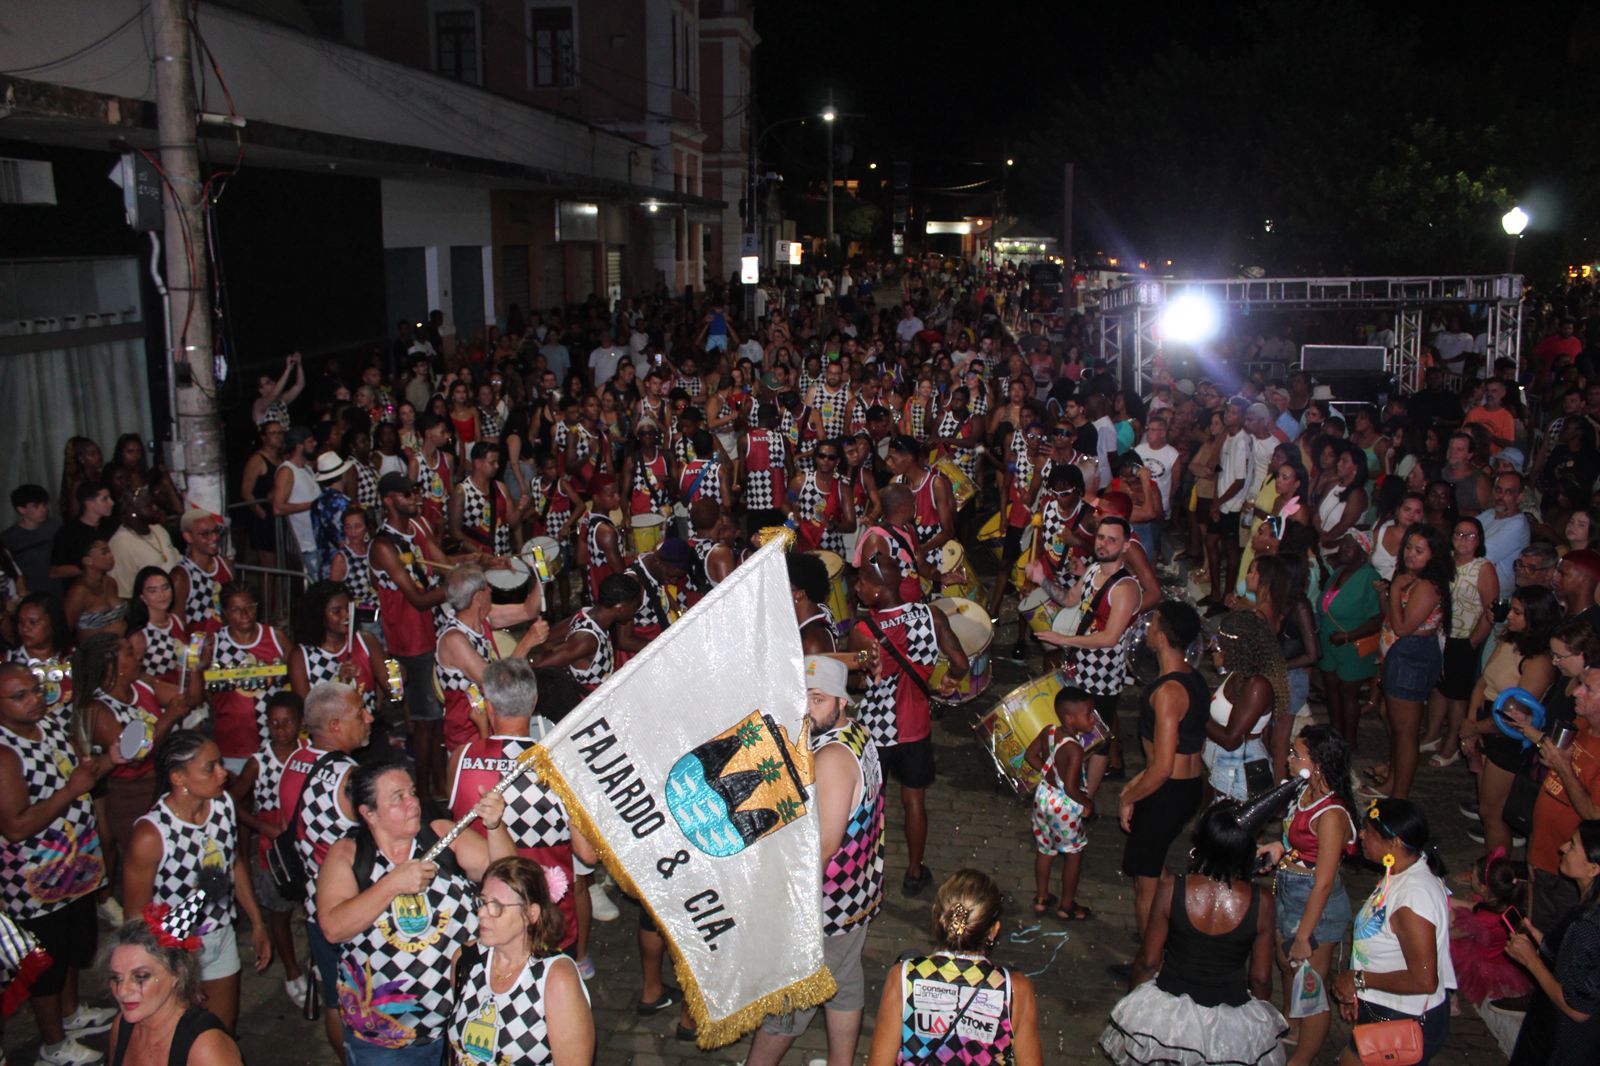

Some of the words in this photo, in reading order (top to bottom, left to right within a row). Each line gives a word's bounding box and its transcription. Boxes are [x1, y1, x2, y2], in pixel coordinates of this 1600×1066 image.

[880, 608, 928, 630] BATERIA
[462, 757, 519, 772] BATER
[570, 717, 666, 839] FAJARDO
[657, 849, 691, 881] &
[684, 889, 737, 952] CIA.
[922, 985, 957, 996] conserta
[961, 1016, 994, 1032] STONE
